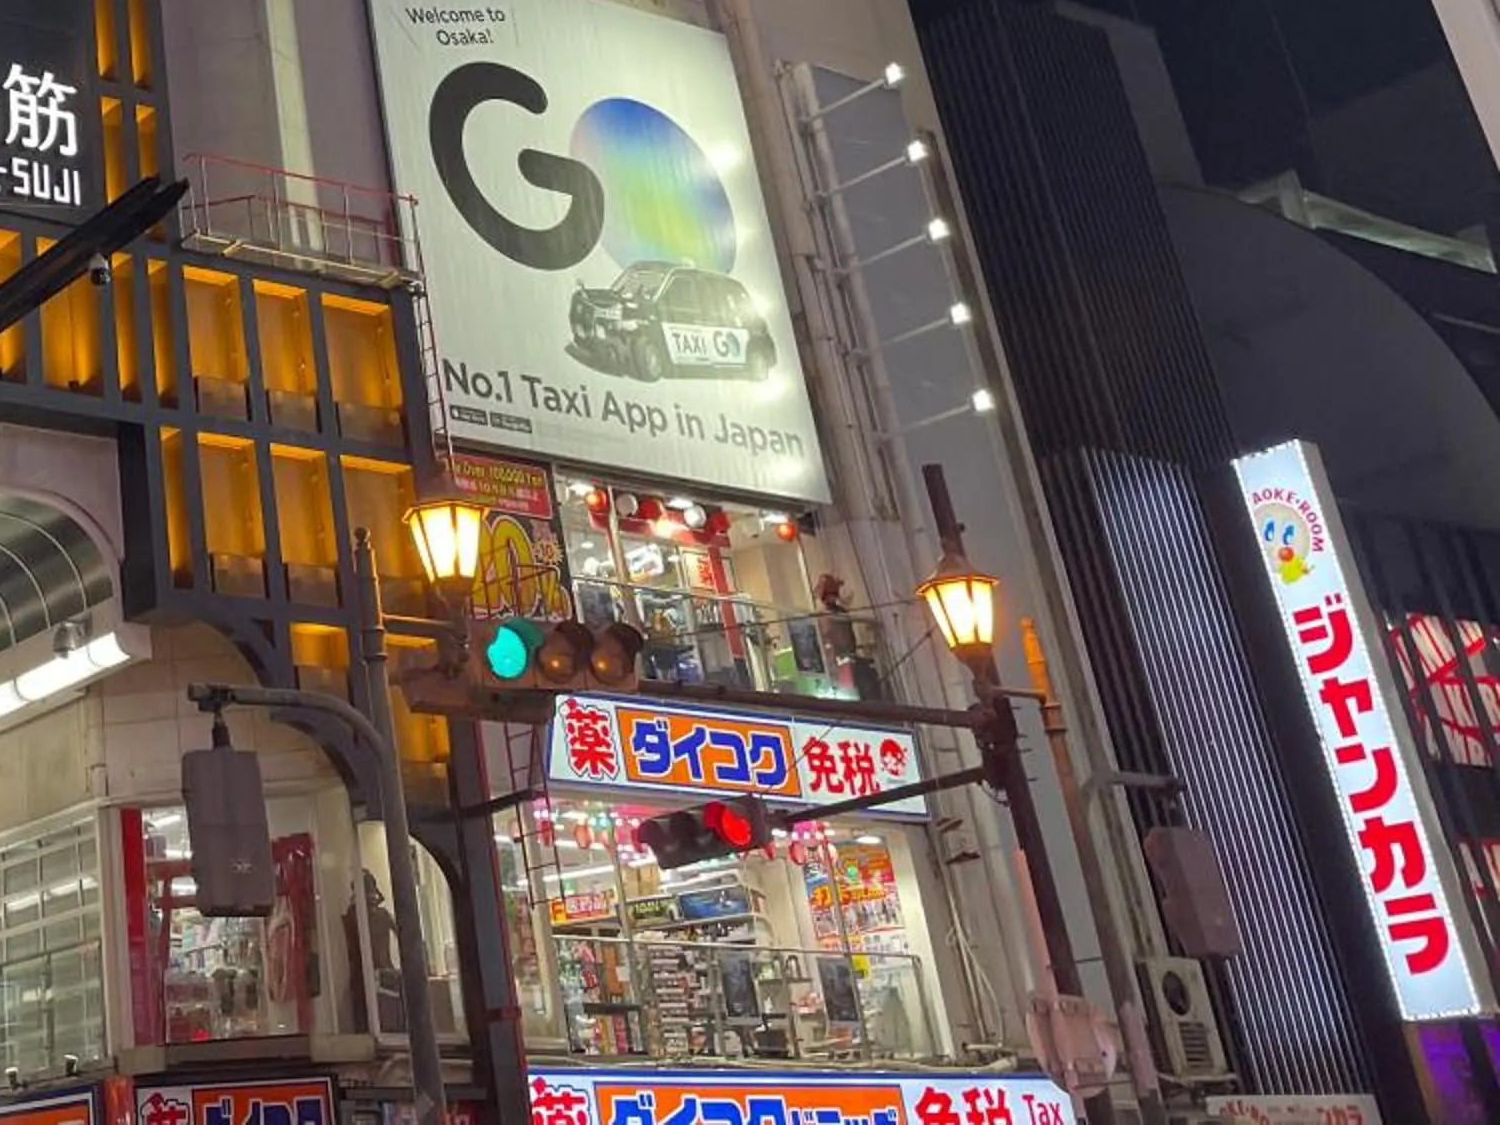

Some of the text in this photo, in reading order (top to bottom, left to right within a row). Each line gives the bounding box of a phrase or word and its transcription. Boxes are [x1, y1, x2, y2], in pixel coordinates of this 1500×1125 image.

[405, 5, 506, 24] Welcome to
[435, 28, 494, 46] Osaka!
[429, 61, 737, 275] GO
[671, 332, 708, 354] TAXI
[442, 358, 513, 404] No.1
[520, 374, 592, 419] Taxi
[600, 391, 669, 438] App
[675, 404, 706, 440] in
[714, 413, 806, 458] Japan
[562, 697, 882, 797] 薬 ダイコク 免税
[1292, 593, 1451, 977] ジャンカラ
